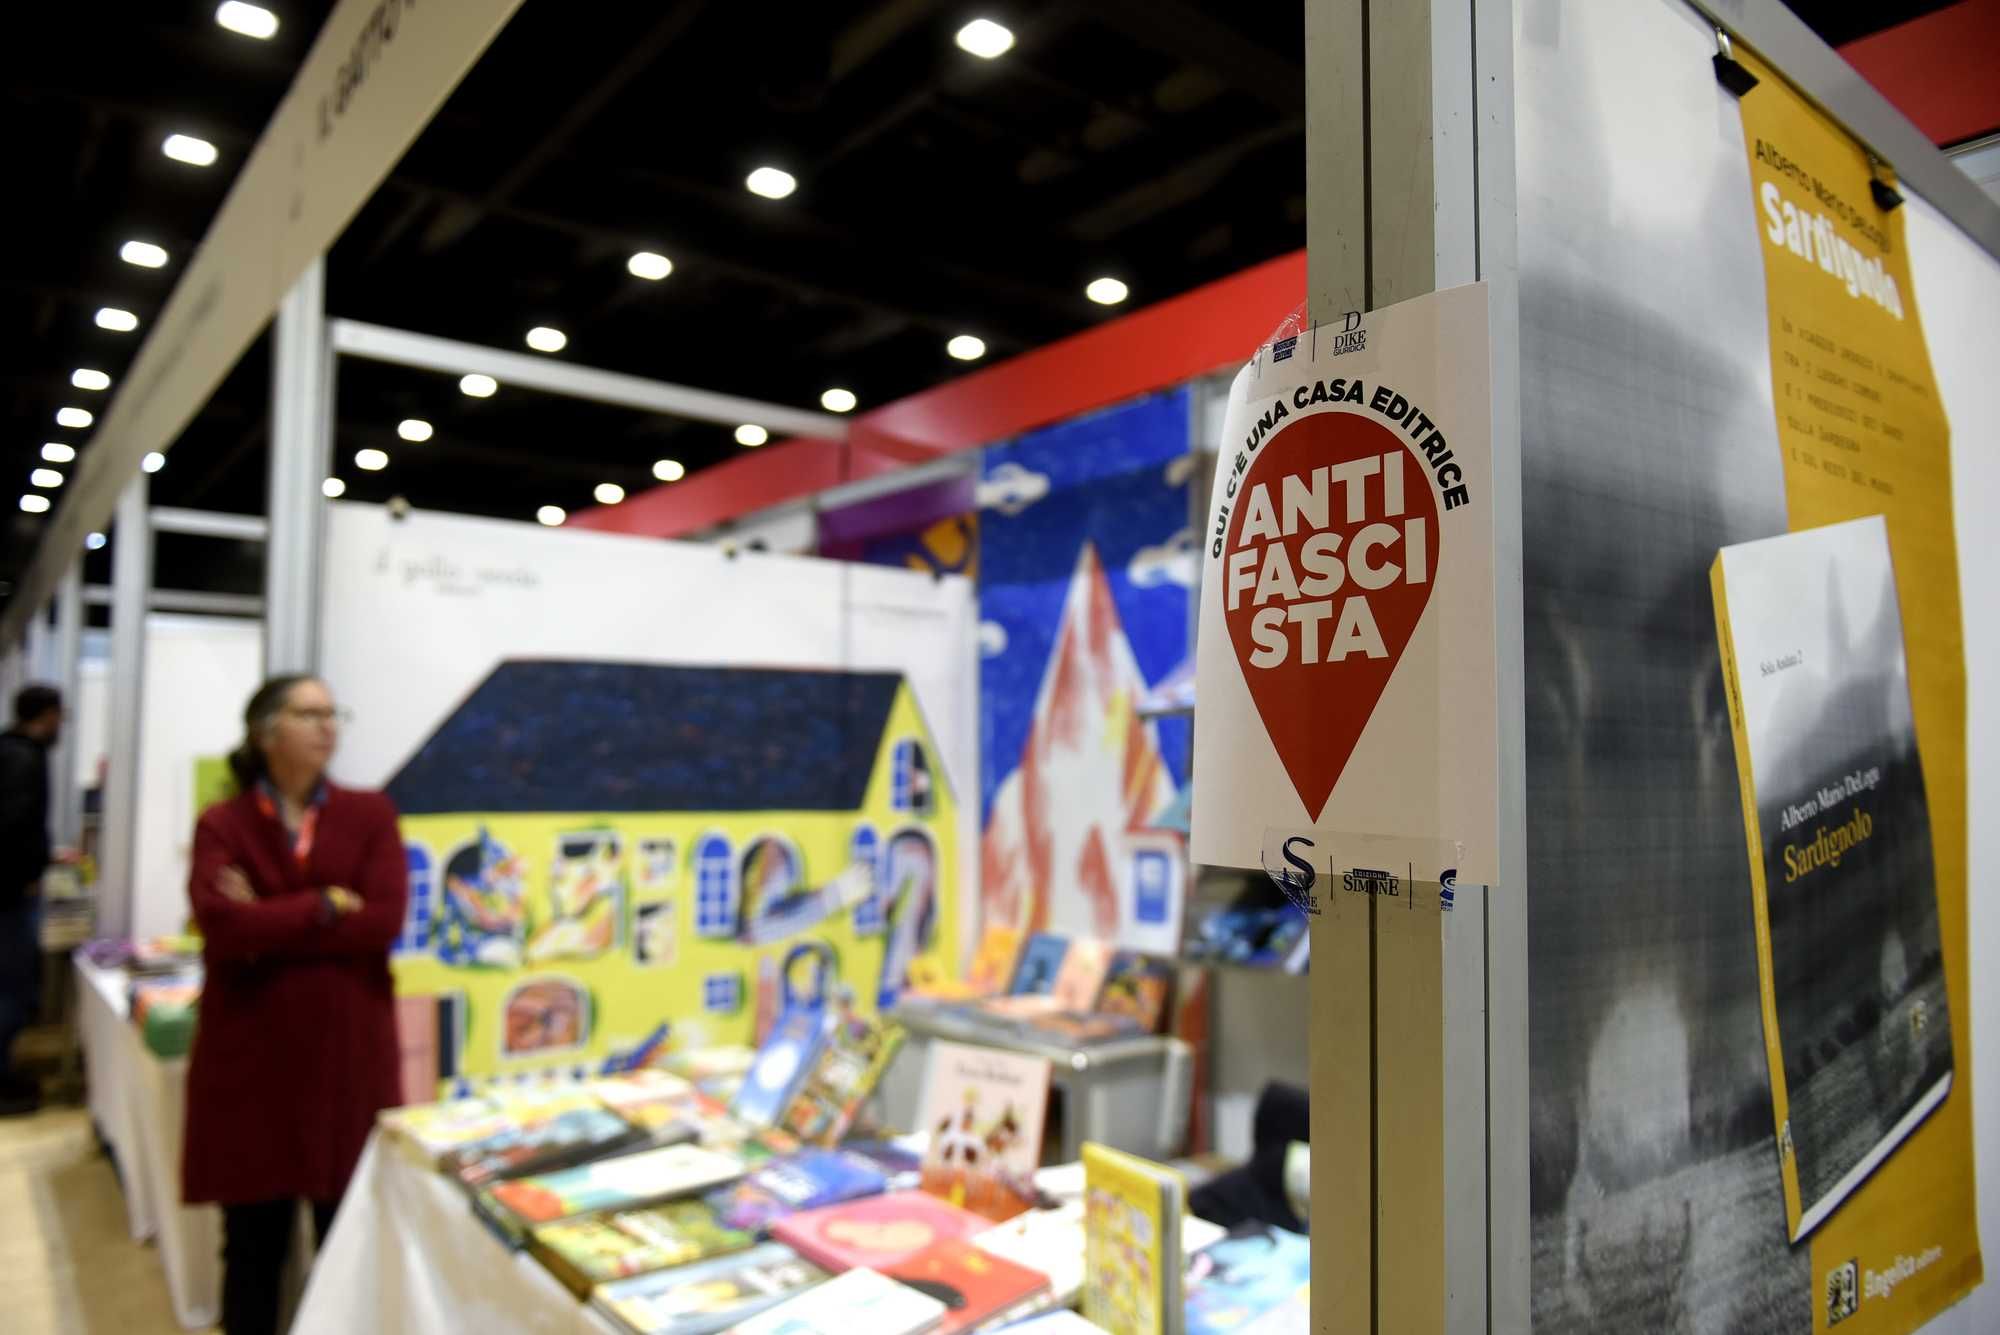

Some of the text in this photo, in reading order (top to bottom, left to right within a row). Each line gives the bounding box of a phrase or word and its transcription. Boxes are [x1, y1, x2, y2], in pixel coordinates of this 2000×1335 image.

[1756, 138, 1811, 192] Alberto
[1761, 181, 1904, 320] Sardignolo
[1333, 343, 1366, 356] GIURIDICA
[1334, 330, 1367, 350] DIKE
[1212, 505, 1230, 560] QUI
[1246, 399, 1290, 453] UNA
[1293, 378, 1364, 410] CASA
[1370, 385, 1470, 511] EDITRICE
[1238, 450, 1405, 548] ANTI
[1228, 517, 1427, 612] FASCI
[1249, 595, 1390, 669] STA
[1781, 804, 1818, 832] Alberto
[1817, 781, 1845, 811] Mario
[1353, 870, 1387, 881] EDIZIONI
[1784, 808, 1873, 883] Sardignolo
[1343, 874, 1399, 897] SIMONE
